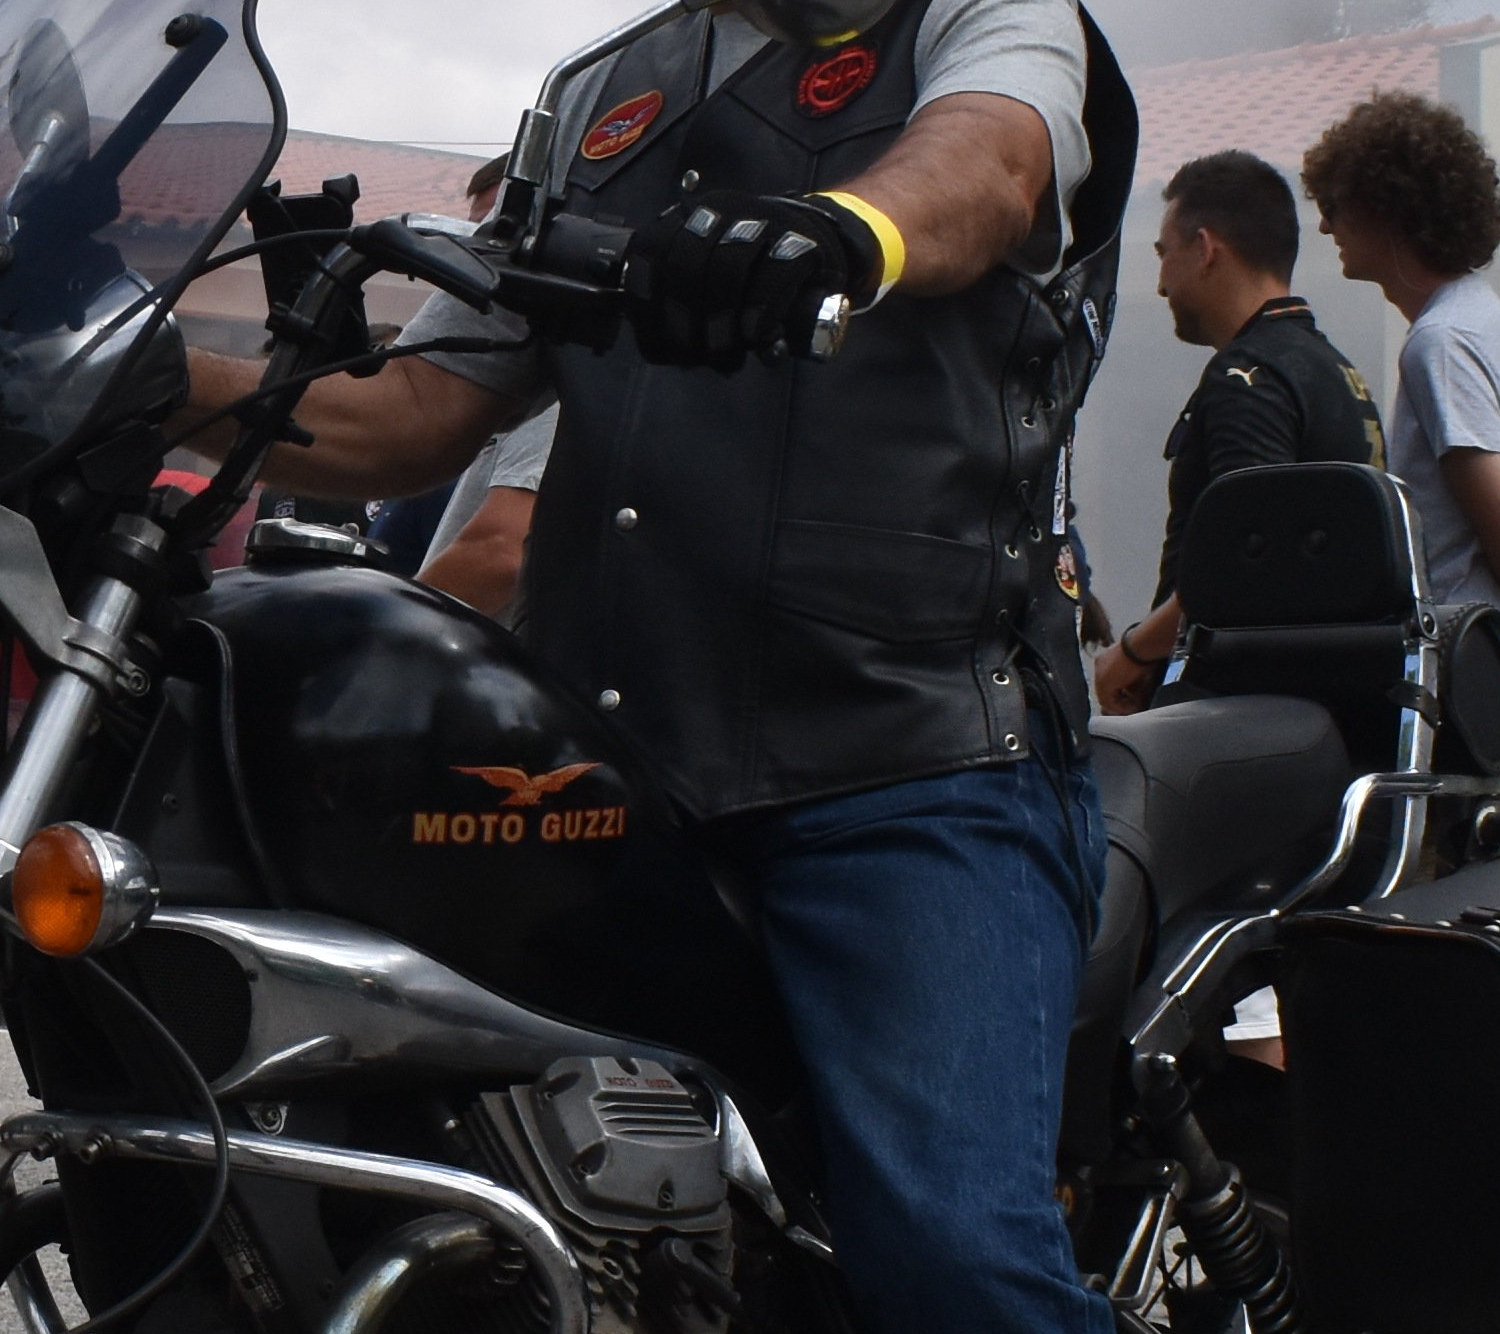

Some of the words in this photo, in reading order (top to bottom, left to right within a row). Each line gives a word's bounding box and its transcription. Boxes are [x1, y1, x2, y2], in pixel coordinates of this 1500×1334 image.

[411, 812, 526, 844] MOTO
[540, 807, 626, 842] GUZZI
[604, 1076, 638, 1088] MOTO
